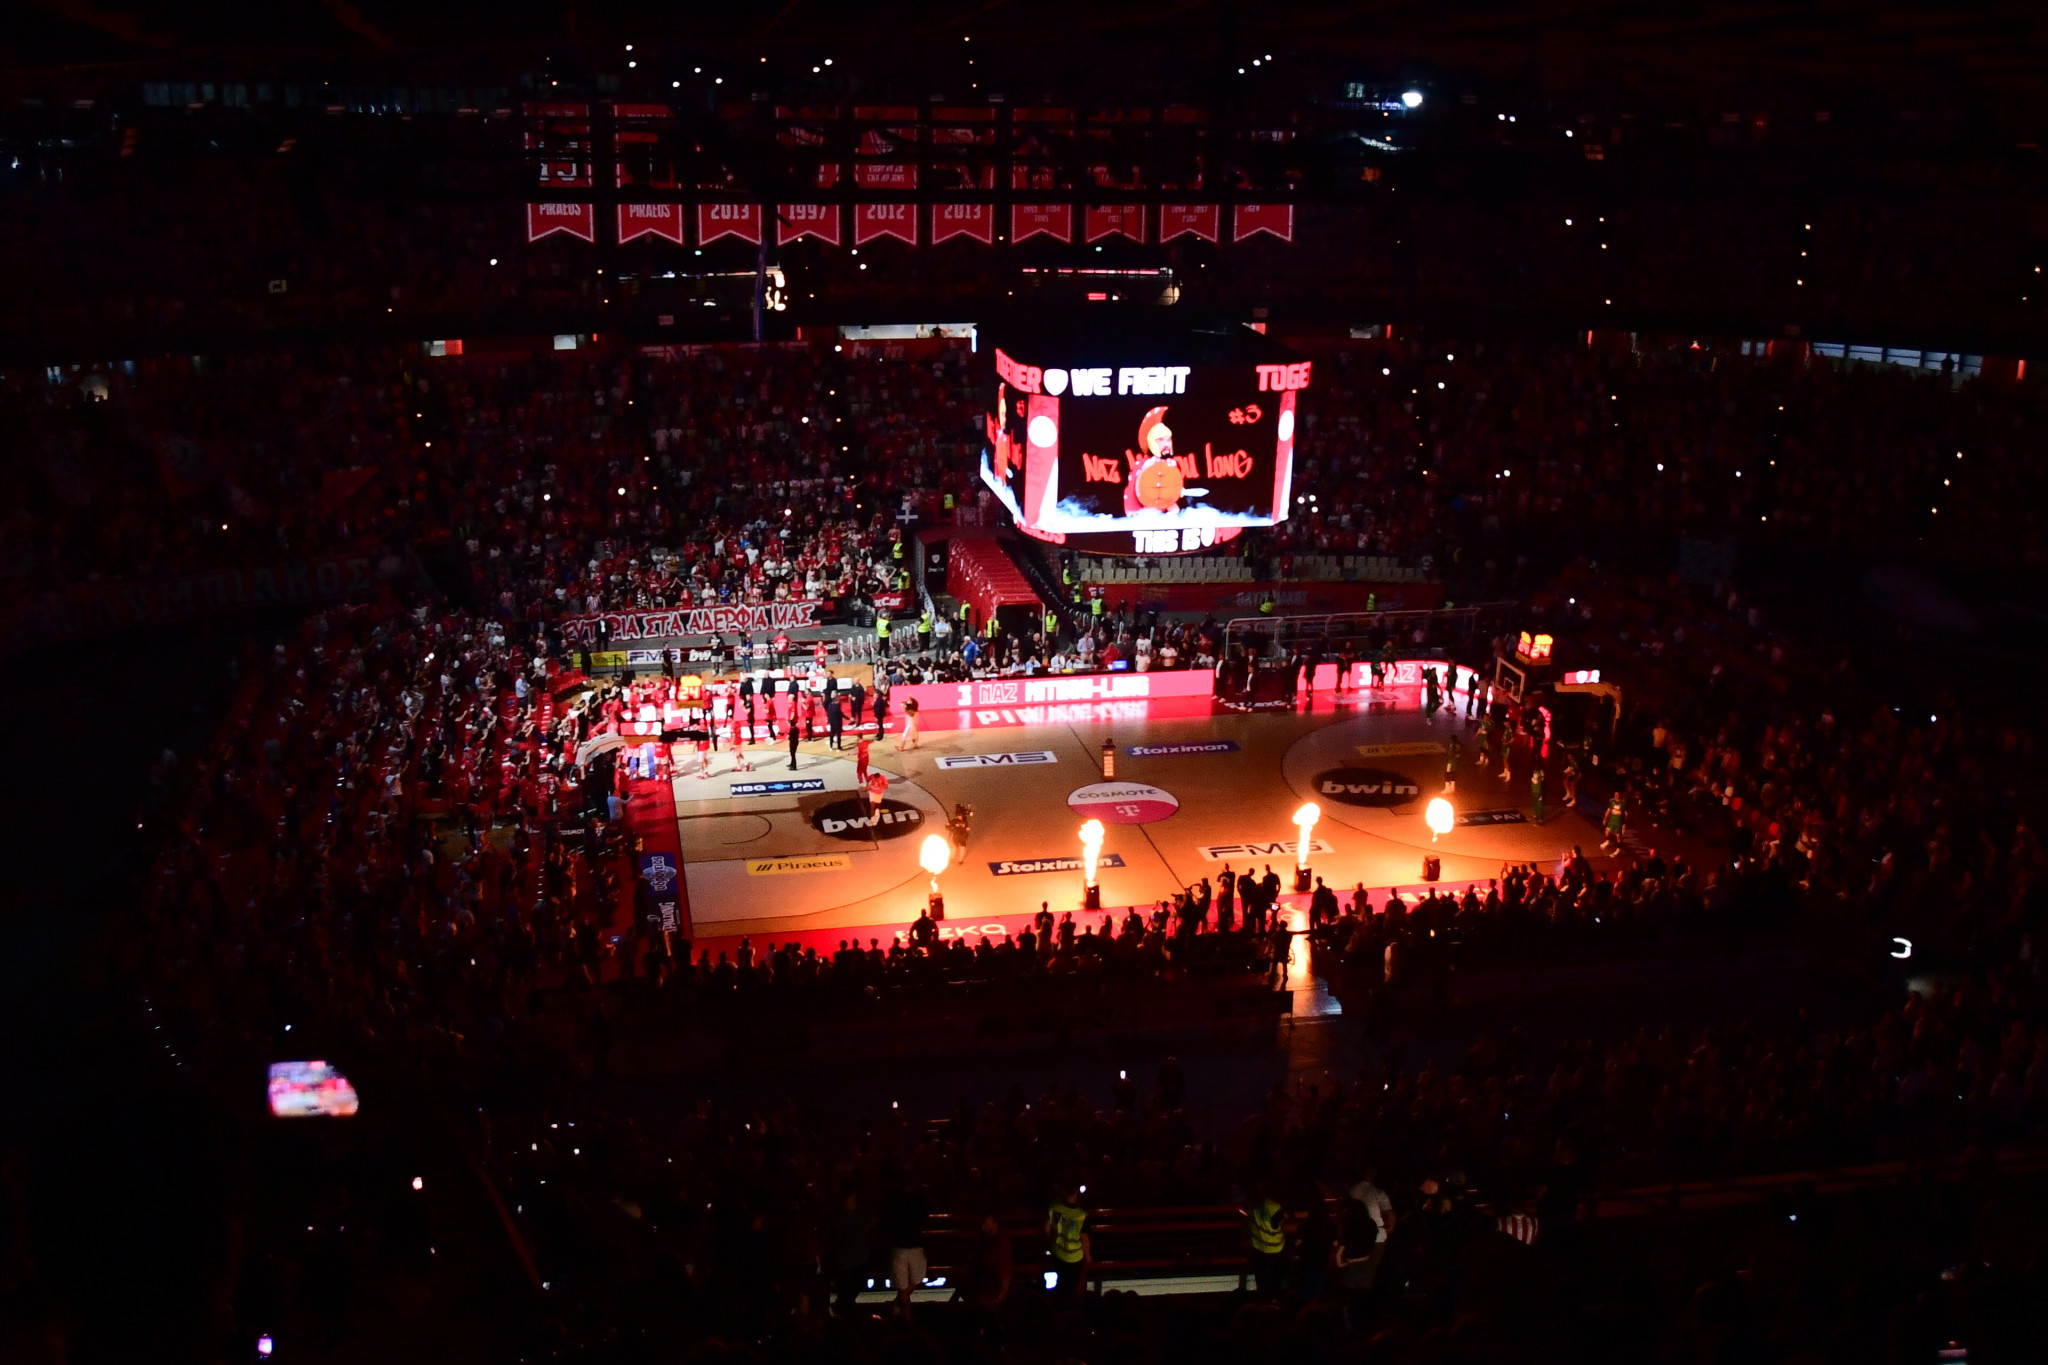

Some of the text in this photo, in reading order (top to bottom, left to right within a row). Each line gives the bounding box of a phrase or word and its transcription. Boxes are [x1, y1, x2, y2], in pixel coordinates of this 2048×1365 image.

[539, 203, 581, 216] PIRAEUS
[629, 204, 670, 218] PIRAEUS
[710, 204, 749, 220] 2013
[789, 204, 826, 220] 1997
[867, 204, 905, 220] 2012
[944, 204, 982, 220] 2013
[1070, 368, 1112, 396] WE
[1118, 366, 1191, 395] FIGHT
[1132, 529, 1179, 553] THIS
[1182, 528, 1201, 551] IS
[642, 611, 685, 639] ΣΤΑ
[771, 602, 816, 630] ΜΑΣ
[1529, 644, 1551, 660] 24
[677, 687, 701, 702] 24
[958, 685, 972, 706] 3
[979, 683, 1018, 704] NAZ
[1131, 742, 1229, 756] Stoiximan
[944, 751, 1048, 767] FMS
[730, 779, 823, 794] NBG PAY
[1077, 788, 1158, 799] COSMOTE
[1321, 779, 1418, 796] bwin
[822, 808, 920, 834] bwin
[777, 858, 843, 871] Piraeus
[998, 857, 1114, 875] Stoiximn
